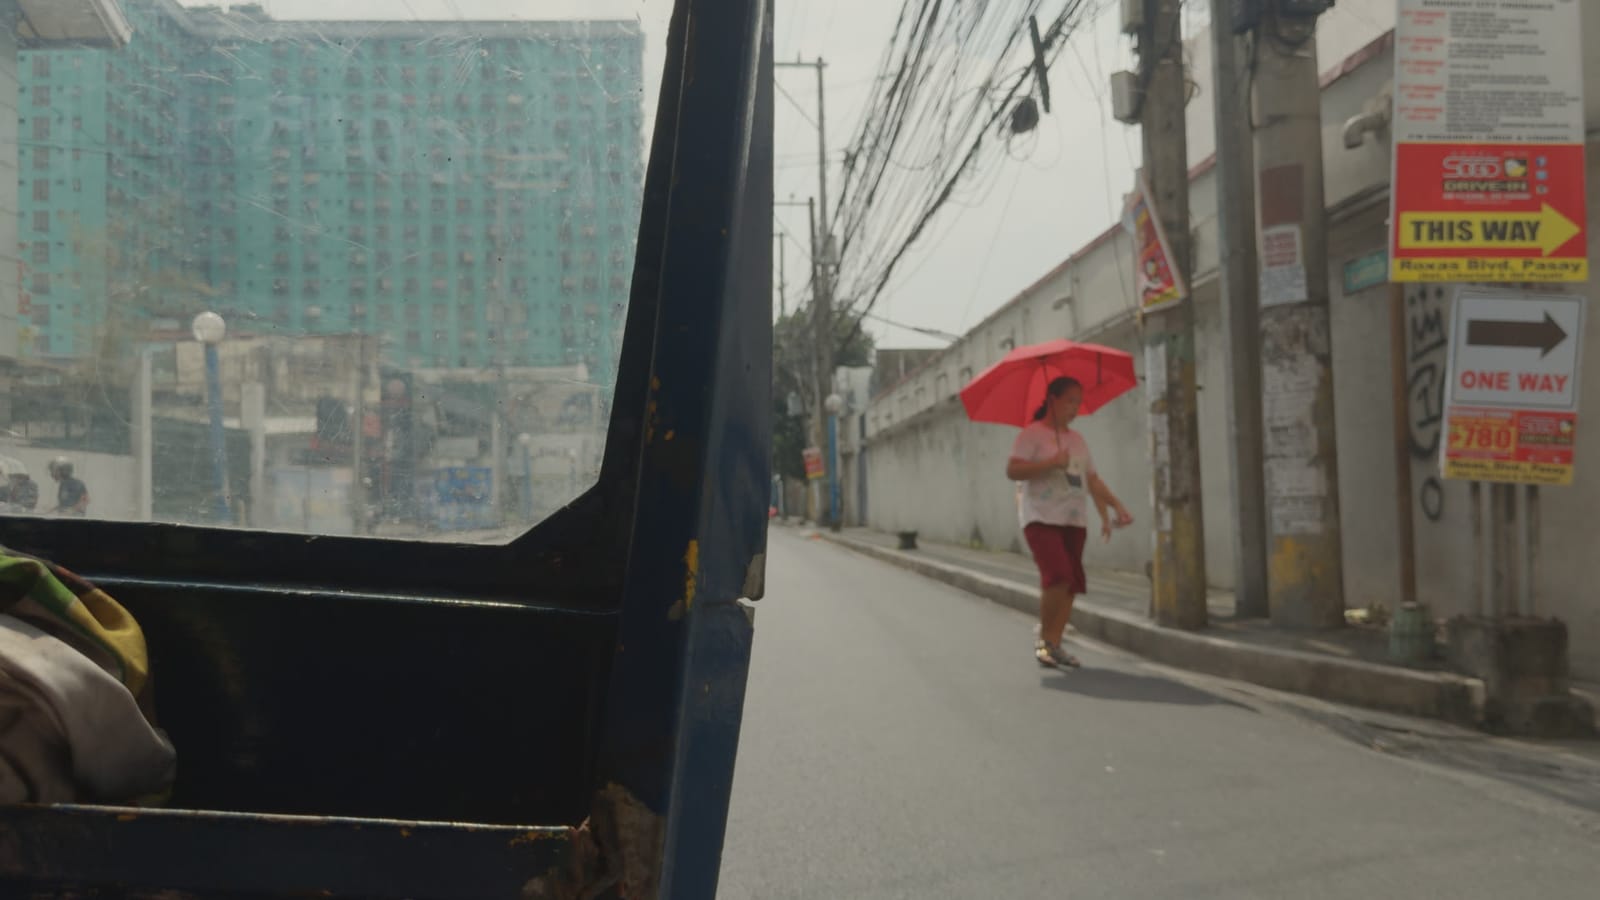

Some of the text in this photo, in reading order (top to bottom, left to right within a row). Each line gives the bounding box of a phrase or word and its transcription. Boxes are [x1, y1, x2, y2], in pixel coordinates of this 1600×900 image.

[1410, 220, 1541, 242] THIS WAY
[1400, 260, 1460, 271] Roxas
[1522, 261, 1582, 272] Pasay
[1460, 370, 1569, 393] ONE WAY
